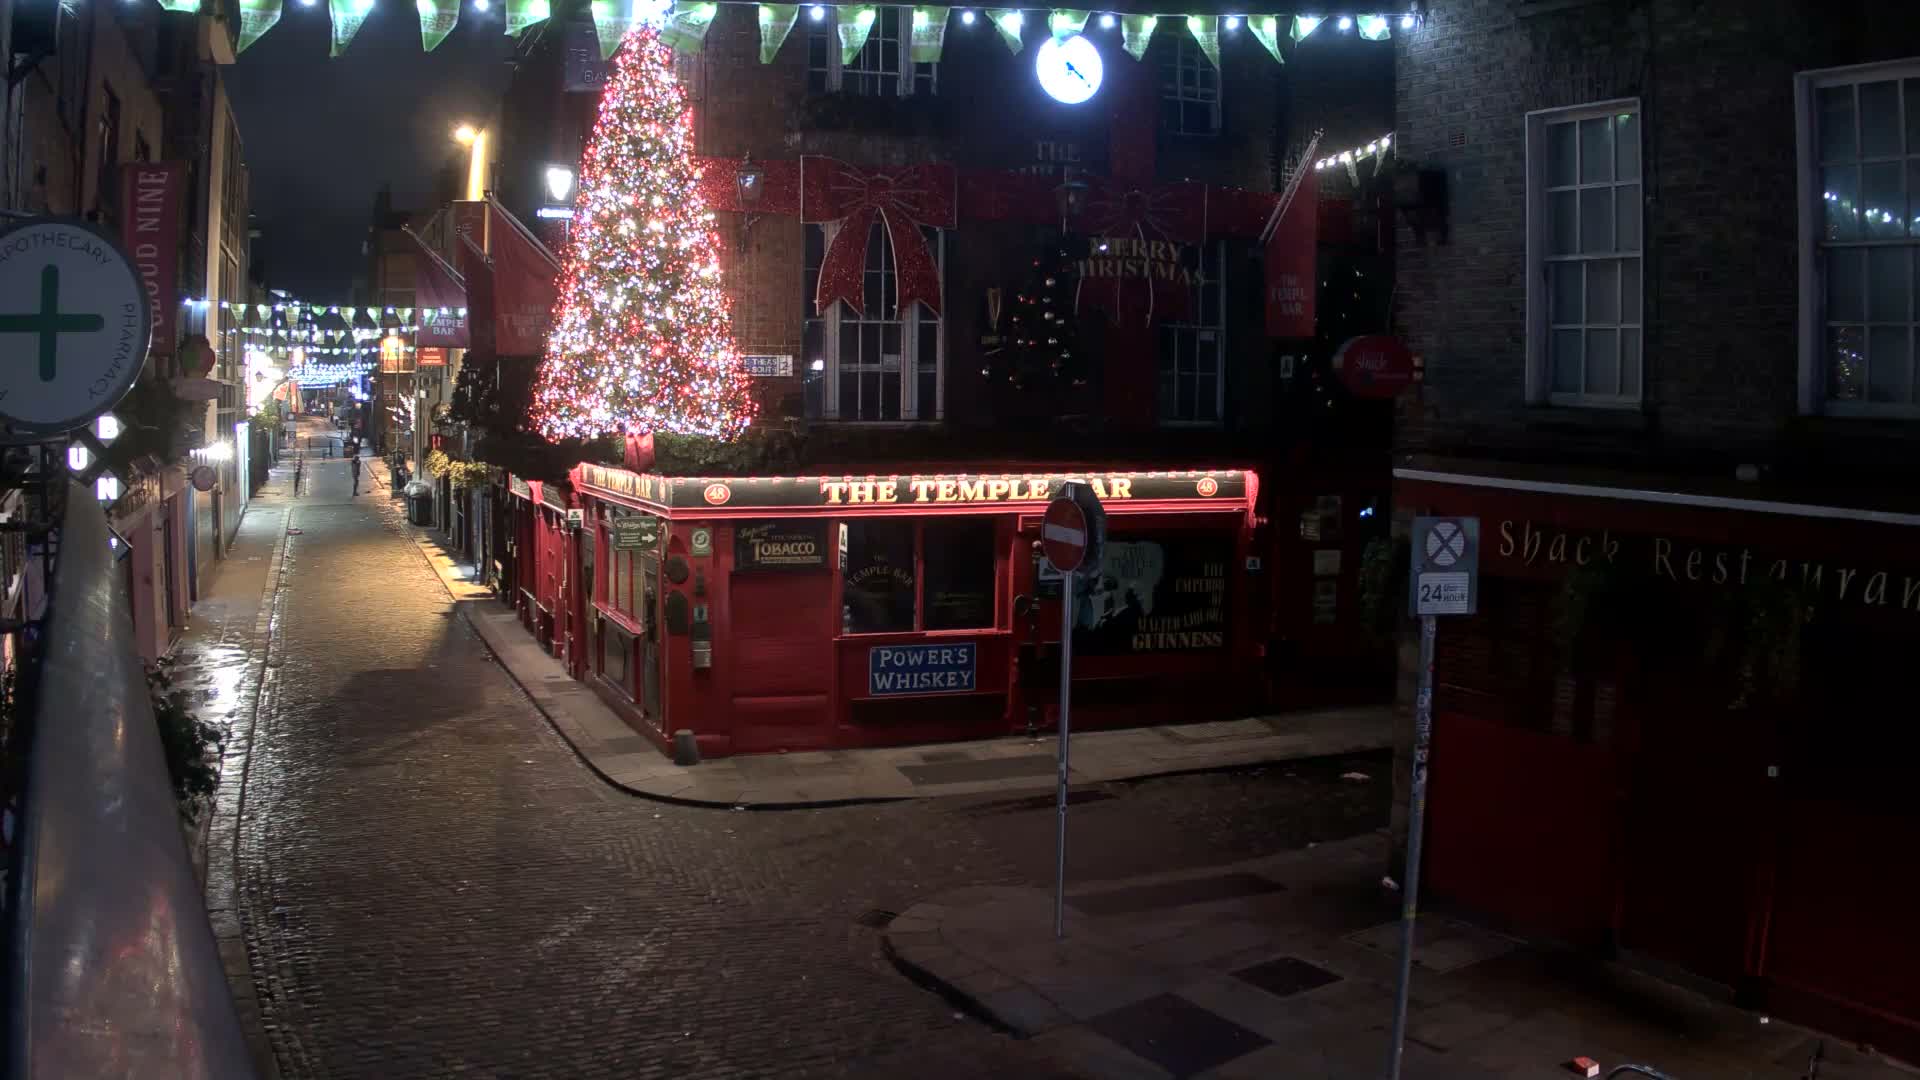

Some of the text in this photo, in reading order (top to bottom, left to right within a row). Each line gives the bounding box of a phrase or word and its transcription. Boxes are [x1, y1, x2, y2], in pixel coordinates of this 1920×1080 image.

[136, 170, 168, 232] NINE
[432, 327, 457, 336] BAR
[88, 302, 137, 401] PHARMACY
[606, 470, 633, 495] TEMPLE
[635, 475, 652, 499] BAR
[820, 480, 898, 503] THE
[911, 478, 1050, 502] TEMPLE
[749, 538, 816, 562] TOBACCO
[1421, 584, 1442, 602] 24
[1131, 631, 1224, 651] GUINNESS
[879, 648, 968, 668] POWER'S
[873, 671, 972, 690] WHISKEY
